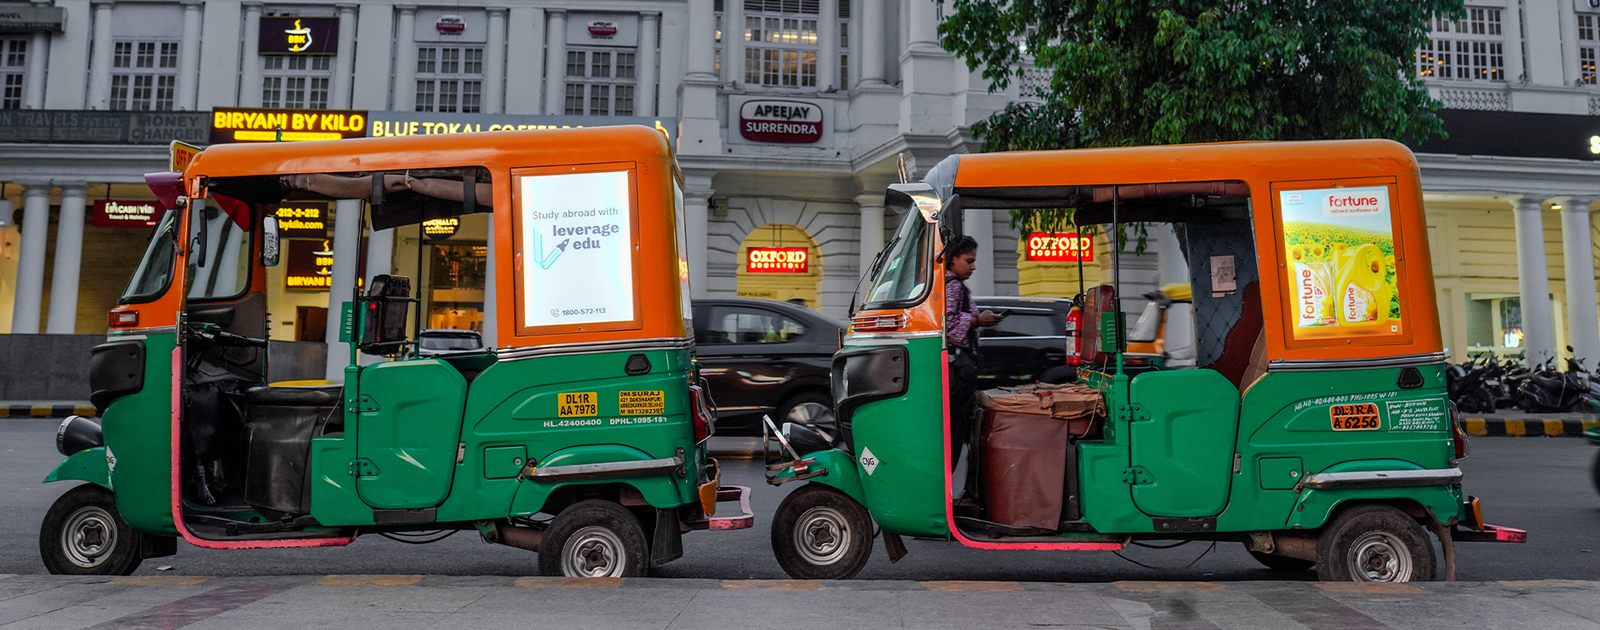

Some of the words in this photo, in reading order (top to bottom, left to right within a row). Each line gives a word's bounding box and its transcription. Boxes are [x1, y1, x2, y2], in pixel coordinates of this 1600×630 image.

[288, 35, 306, 44] BBK
[754, 105, 810, 120] APEEJAY
[18, 113, 79, 126] TRAVELS
[138, 116, 199, 127] MONEY
[214, 111, 288, 130] BIRYANI
[291, 113, 319, 130] BY
[320, 114, 364, 132] KILO
[131, 128, 205, 140] CHANGER
[372, 120, 418, 137] BLUE
[746, 122, 818, 135] SURRENDRA
[1329, 195, 1378, 208] fortune
[532, 211, 559, 220] Study
[562, 208, 596, 219] abroad
[598, 207, 619, 216] with
[552, 223, 620, 237] leverage
[572, 237, 601, 250] edu
[1030, 237, 1091, 250] OXFORD
[750, 250, 806, 263] OXFORD
[287, 276, 325, 286] BIRYANI
[1302, 269, 1315, 320] fortune
[1348, 287, 1357, 320] fortune
[562, 308, 606, 316] 1800-572-113
[566, 394, 590, 404] DL1R
[560, 406, 573, 416] AA
[575, 405, 596, 415] 7978
[543, 419, 602, 427] HL.42400400
